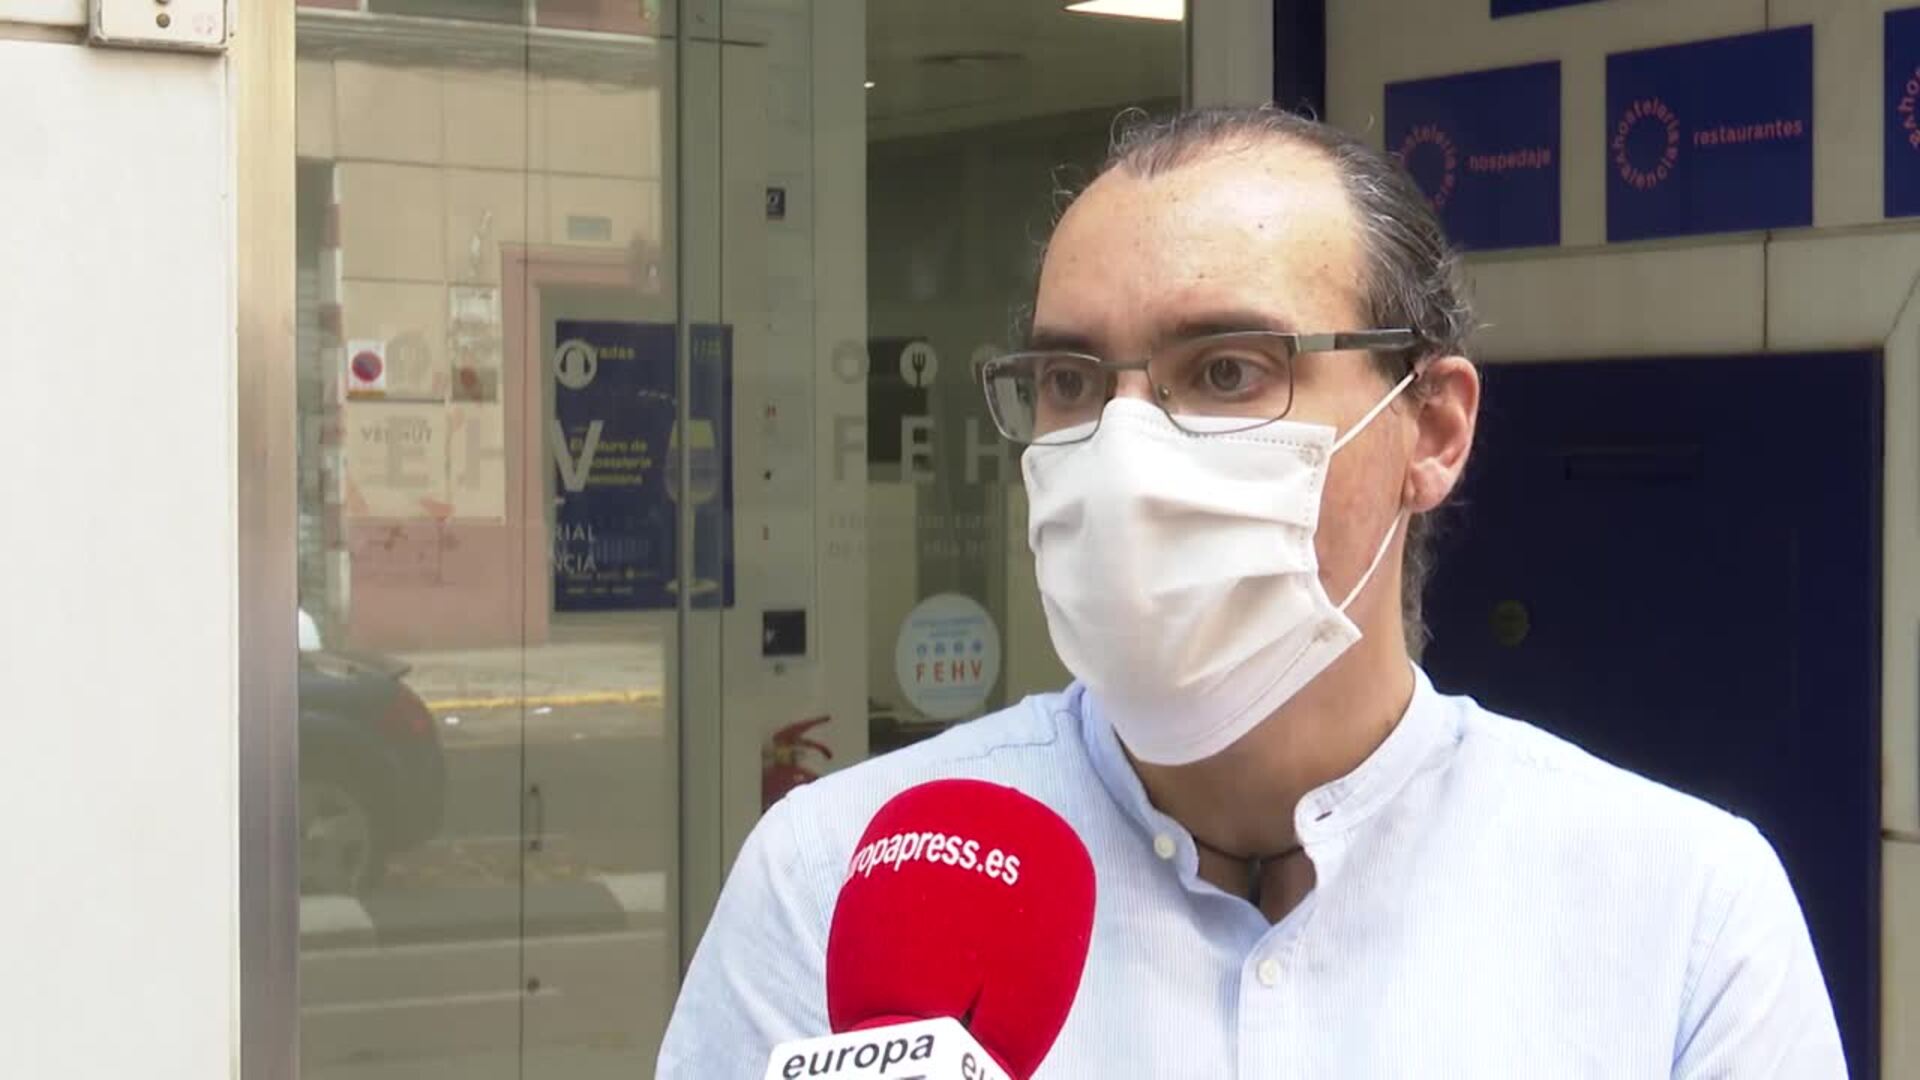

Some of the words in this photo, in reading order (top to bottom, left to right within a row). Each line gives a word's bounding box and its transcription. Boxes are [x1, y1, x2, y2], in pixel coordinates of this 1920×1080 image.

[1694, 119, 1804, 146] restaurantes
[915, 661, 984, 684] FEHV
[850, 831, 1021, 886] ropapress.es
[782, 1033, 936, 1080] europa
